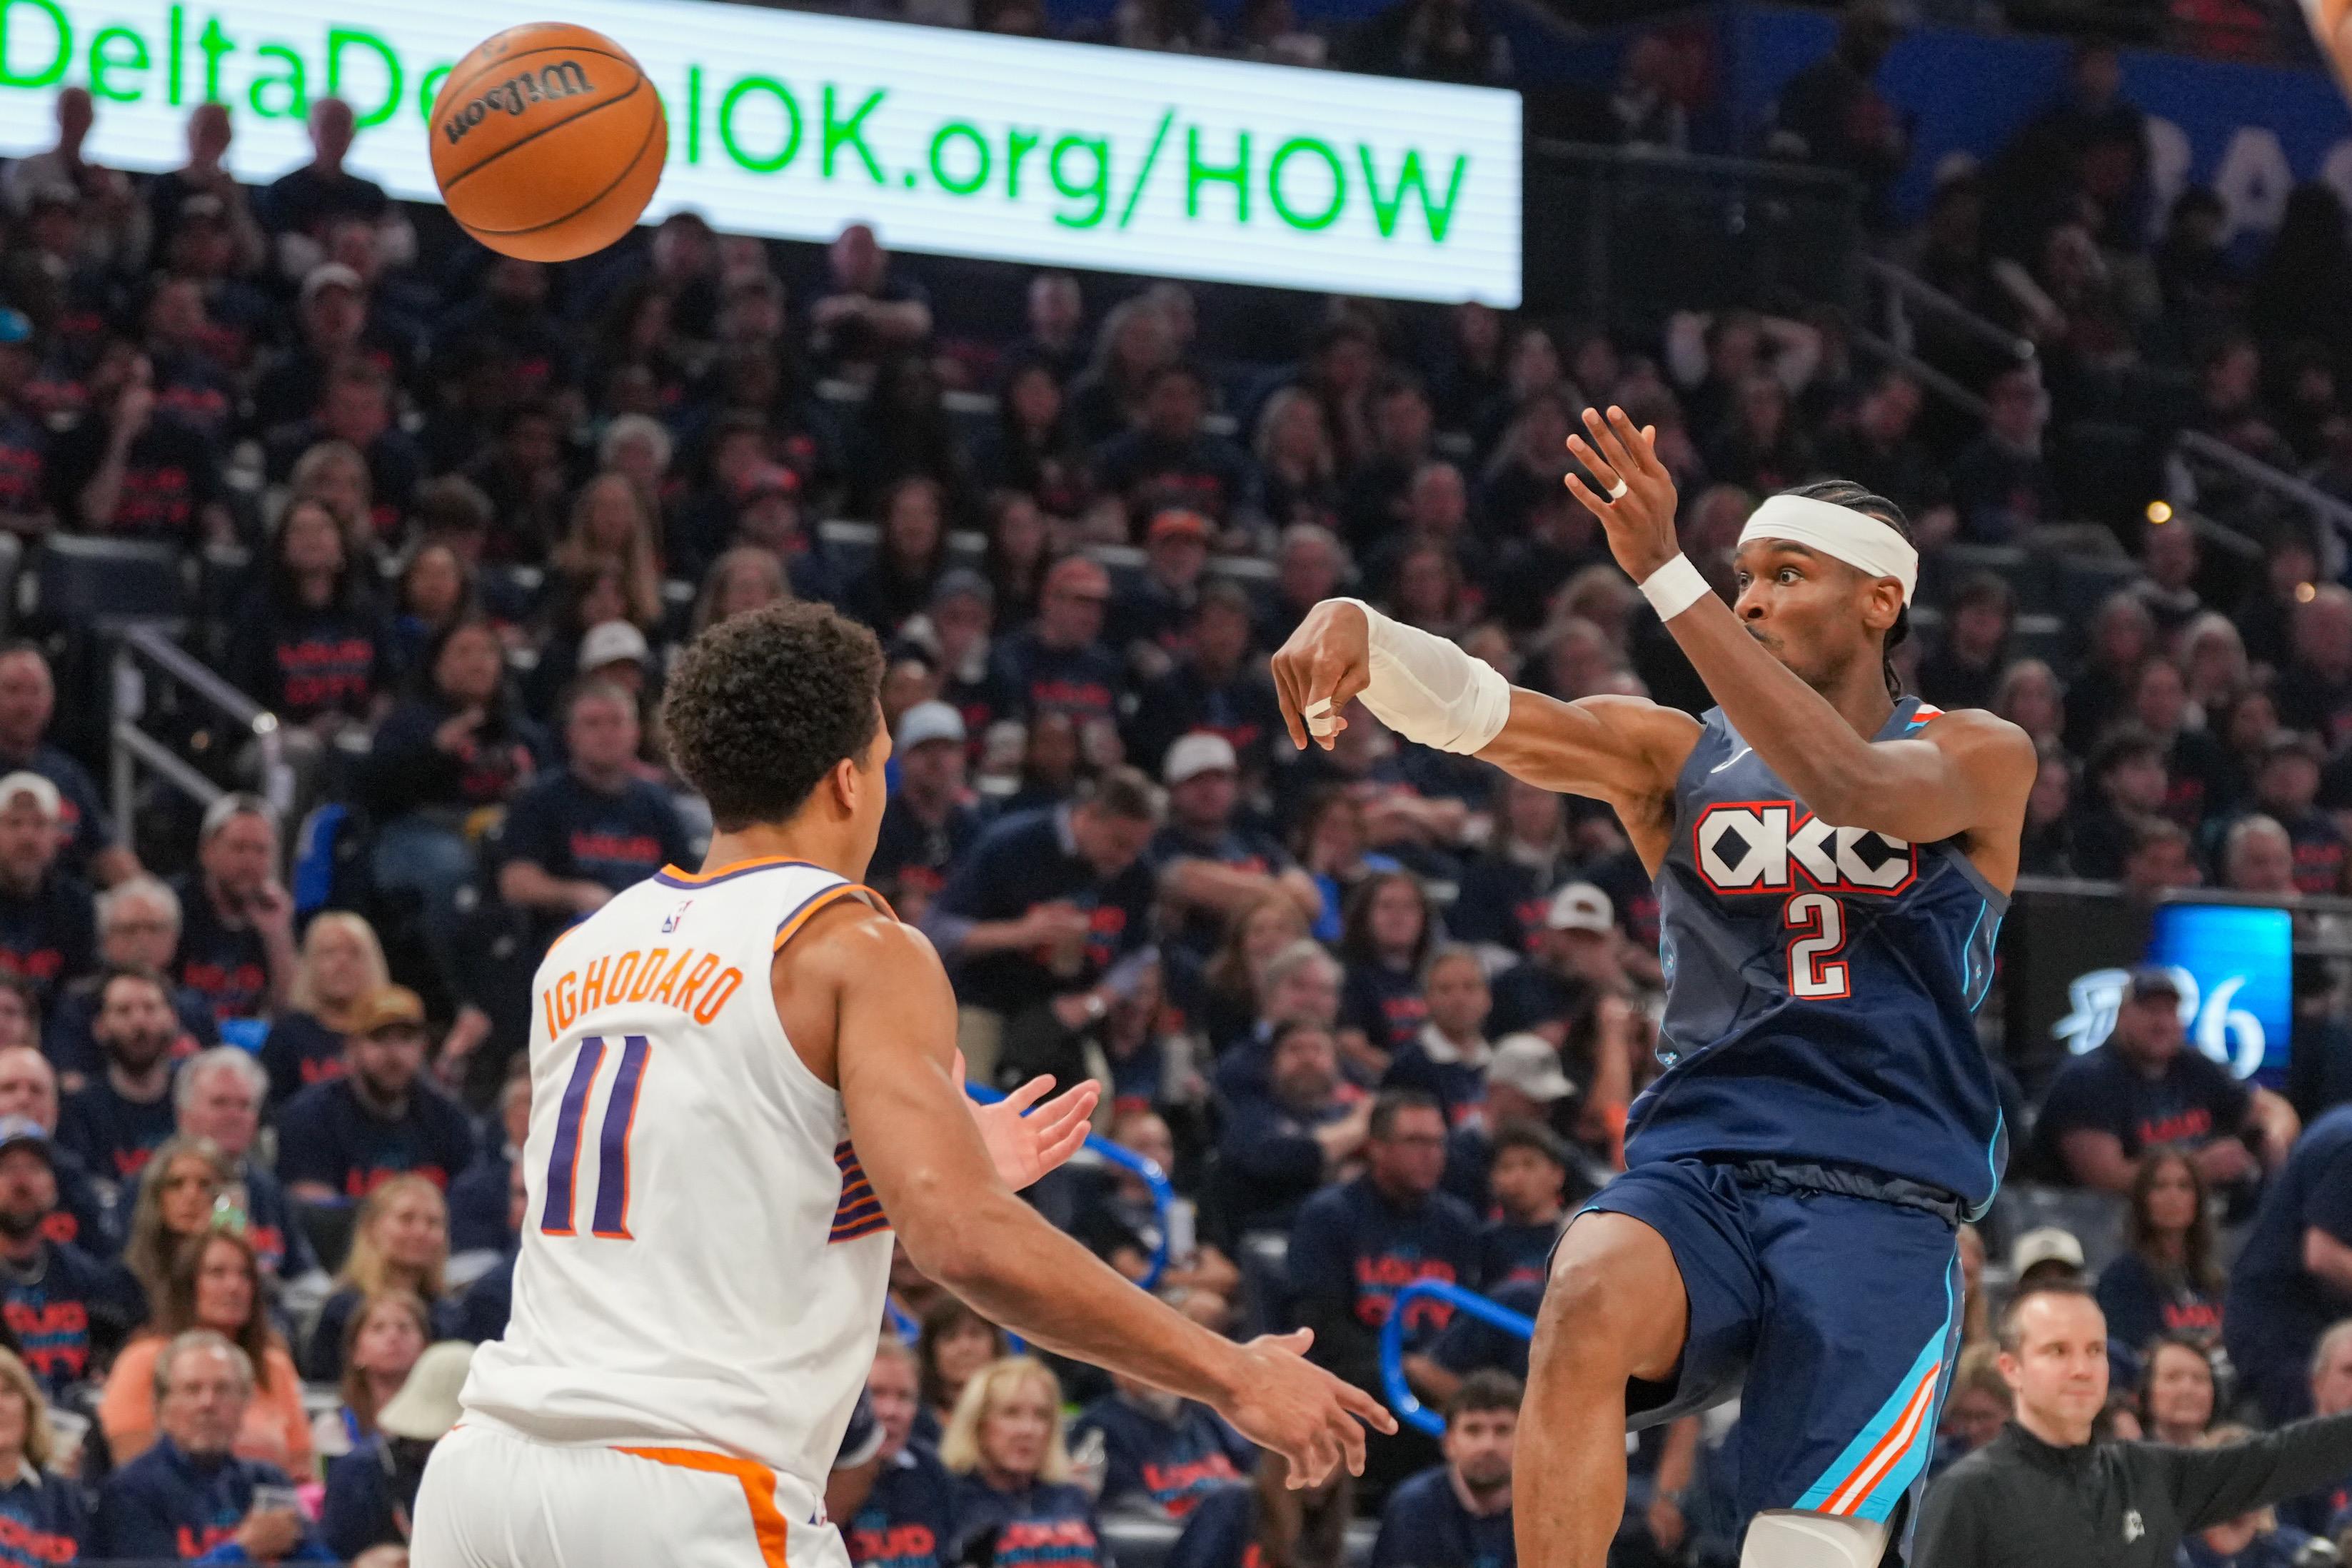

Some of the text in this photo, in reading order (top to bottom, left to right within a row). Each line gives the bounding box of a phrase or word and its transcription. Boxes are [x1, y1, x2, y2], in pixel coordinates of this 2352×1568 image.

[443, 60, 595, 145] Wilson
[1694, 800, 1918, 897] OKC
[1785, 892, 1851, 1000] 2
[543, 948, 743, 1042] IGHODARO
[541, 1035, 652, 1242] 11
